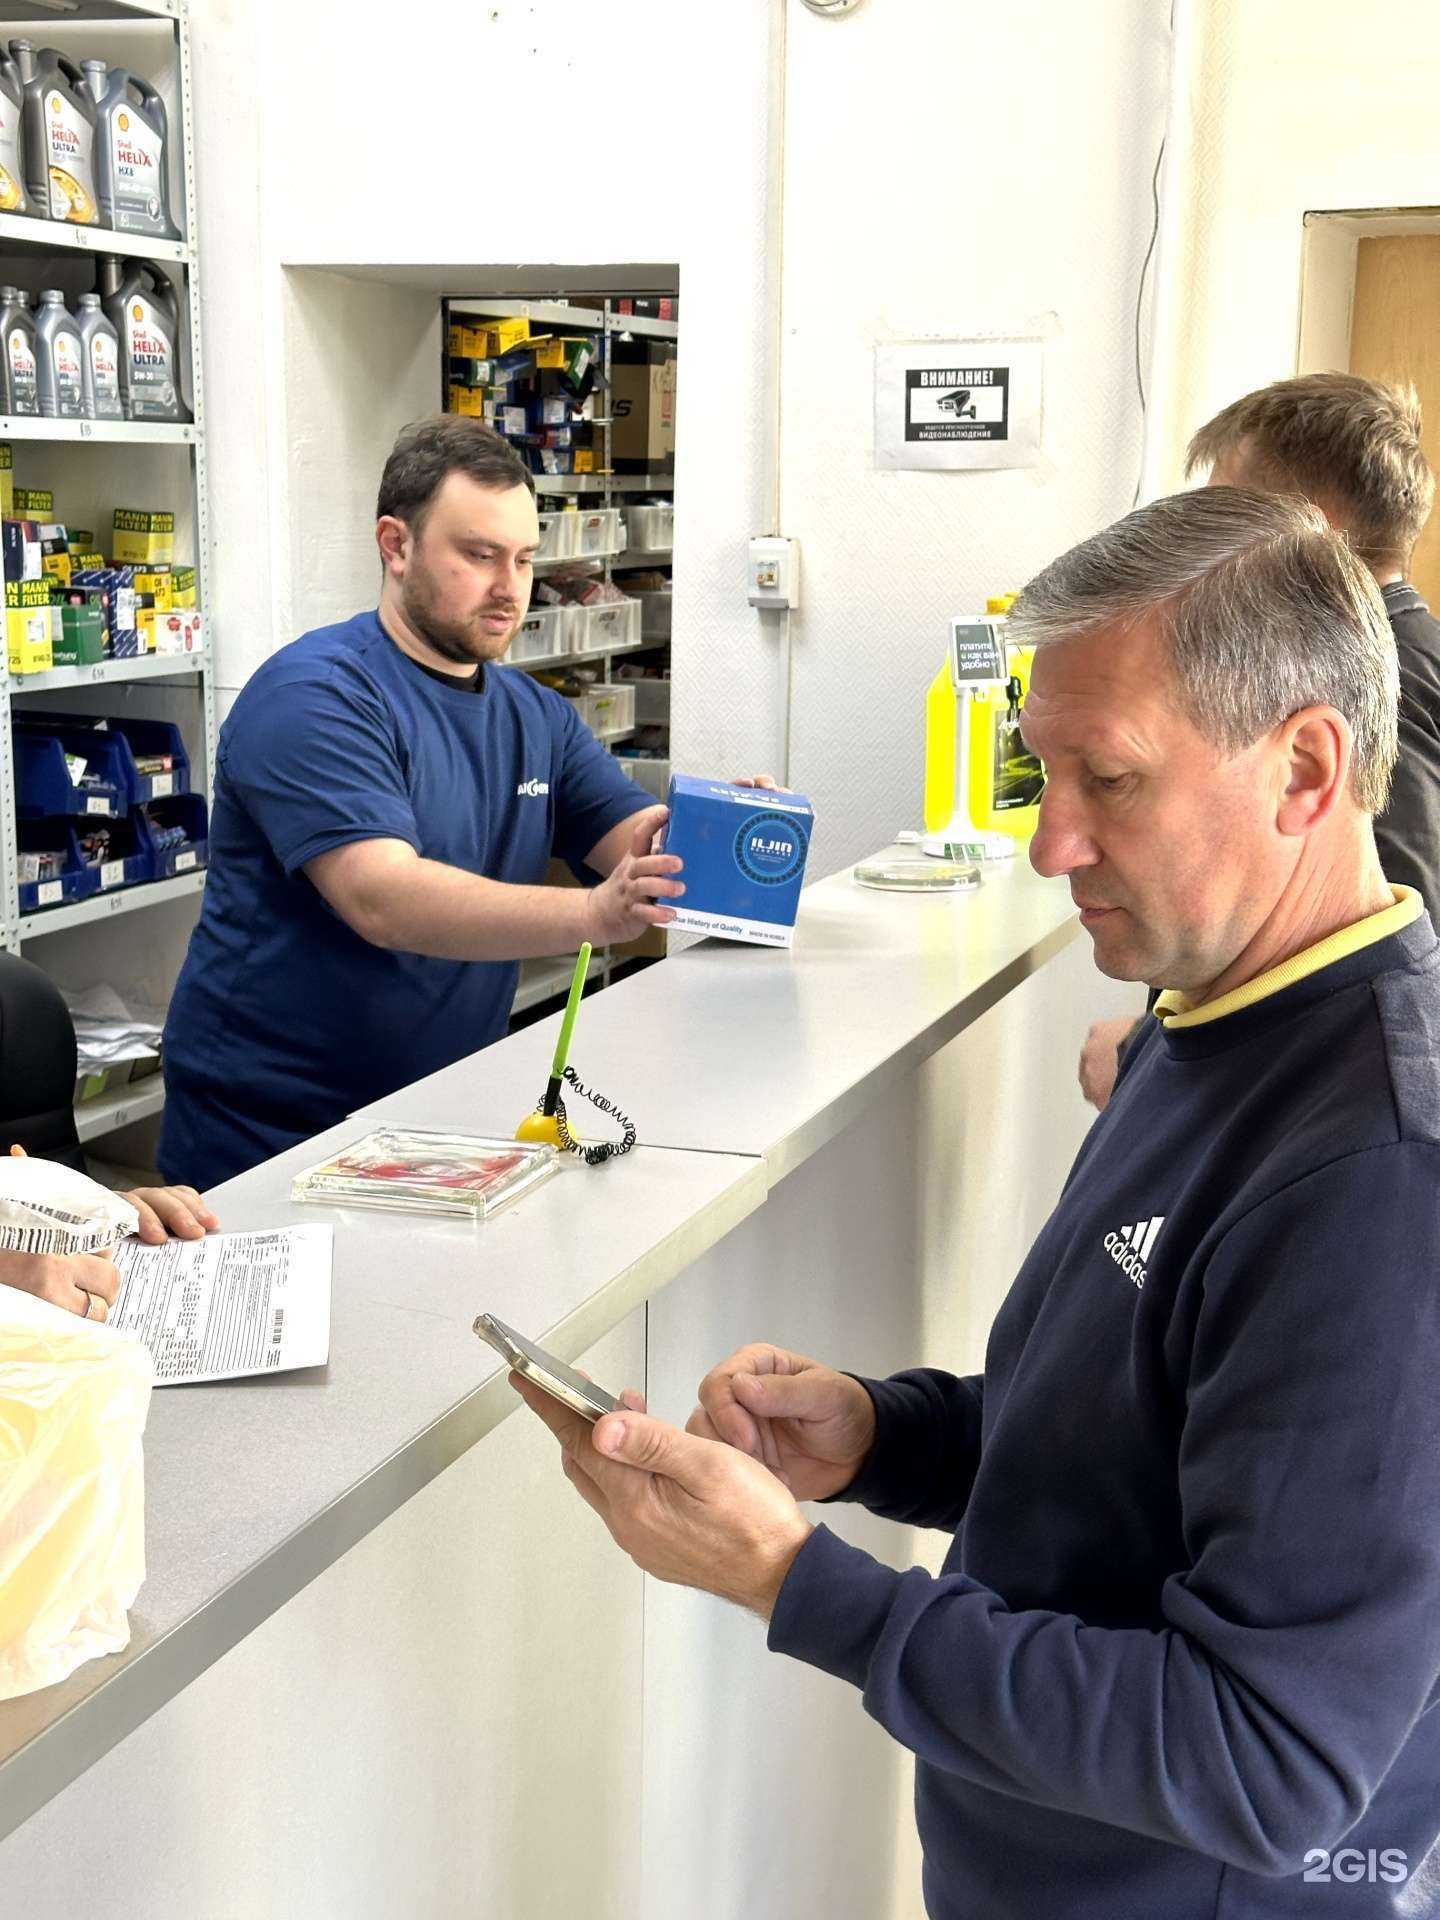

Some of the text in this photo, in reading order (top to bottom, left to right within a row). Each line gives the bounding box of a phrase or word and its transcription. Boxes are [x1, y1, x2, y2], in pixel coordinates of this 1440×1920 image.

[52, 129, 80, 145] HELIX
[53, 142, 76, 153] ULTRA
[118, 149, 153, 167] HELIX
[133, 337, 166, 354] HELIX
[133, 354, 165, 366] ULTRA
[920, 370, 994, 386] ВНИМАНИЕ!
[919, 430, 992, 440] ВИДЕОНАБЛЮДЕНИЕ
[115, 510, 148, 522] MANN
[115, 520, 148, 531] FILTER
[22, 581, 49, 593] MANN
[22, 593, 50, 606] FILTER
[961, 660, 991, 671] удобно
[687, 917, 710, 929] History
[711, 920, 720, 928] of
[720, 923, 744, 934] Quality
[1103, 1231, 1147, 1289] adidas
